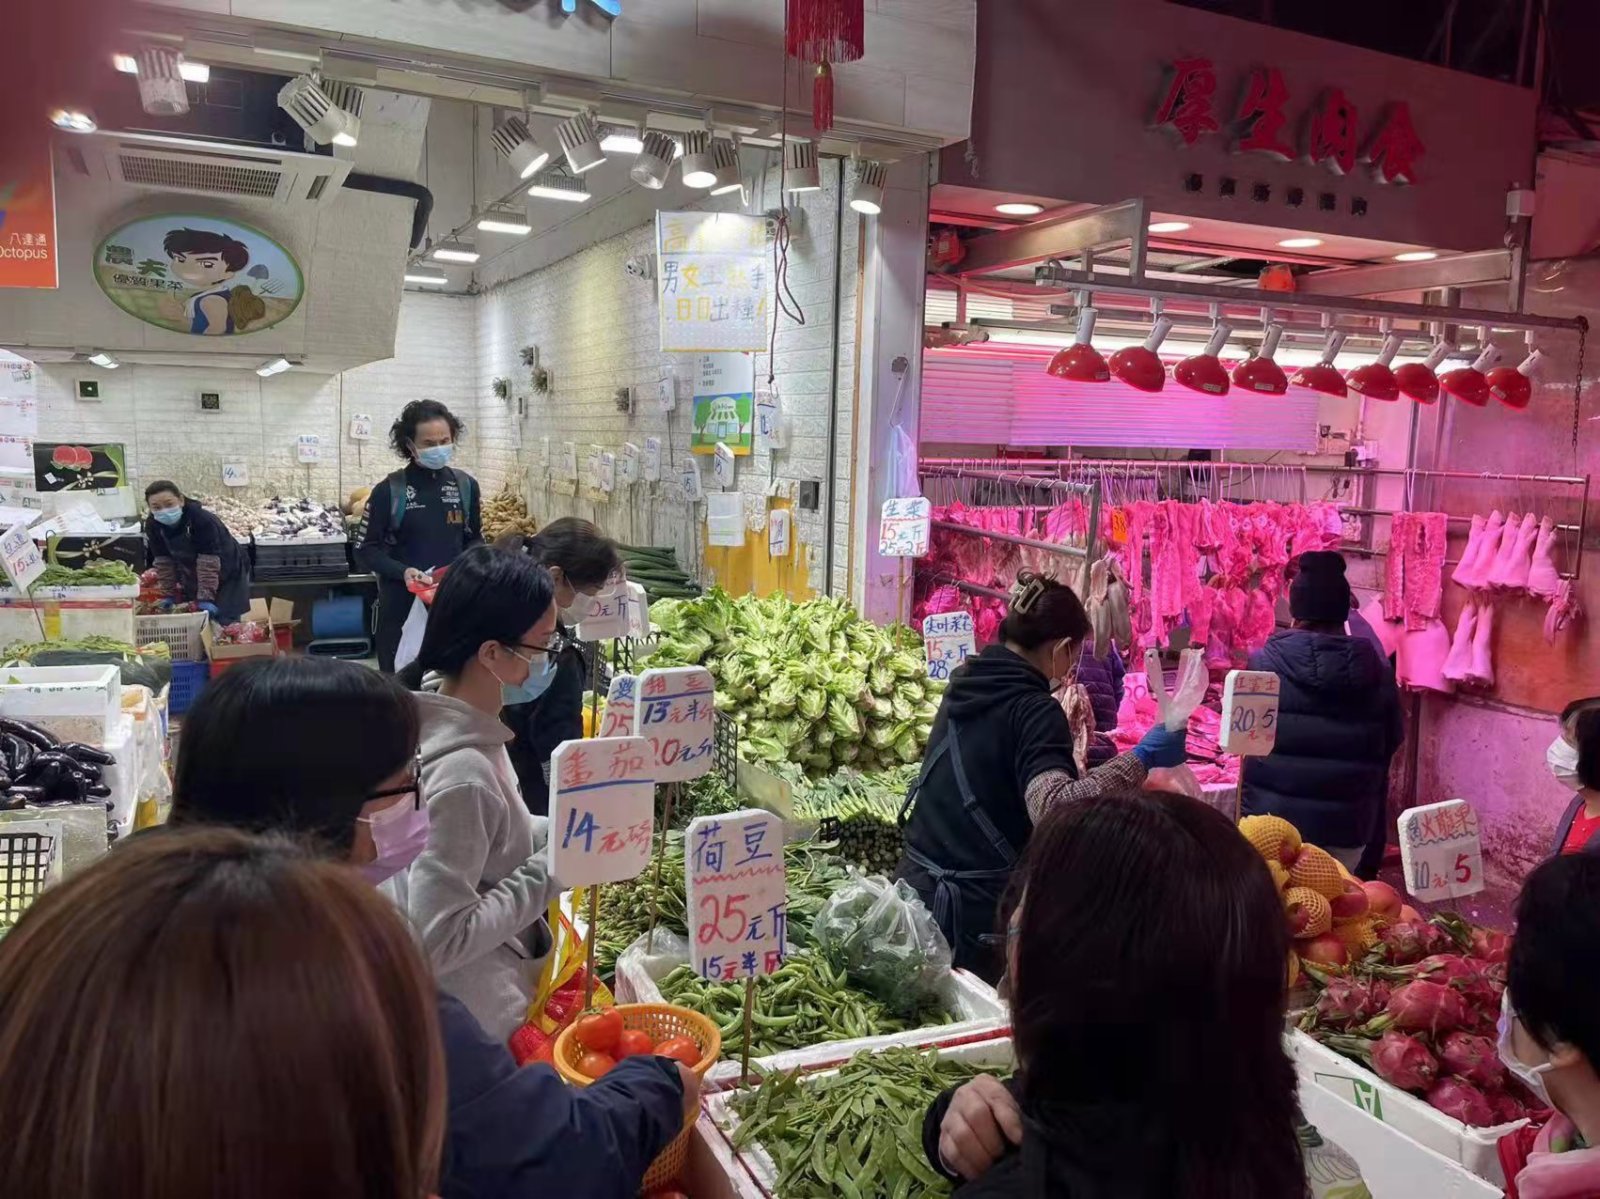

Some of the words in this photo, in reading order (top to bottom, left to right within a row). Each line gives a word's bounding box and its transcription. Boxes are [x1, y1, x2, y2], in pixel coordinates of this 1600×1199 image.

[1155, 57, 1426, 186] 厚生肉食
[10, 233, 47, 246] 八達通
[692, 821, 774, 873] 荷豆
